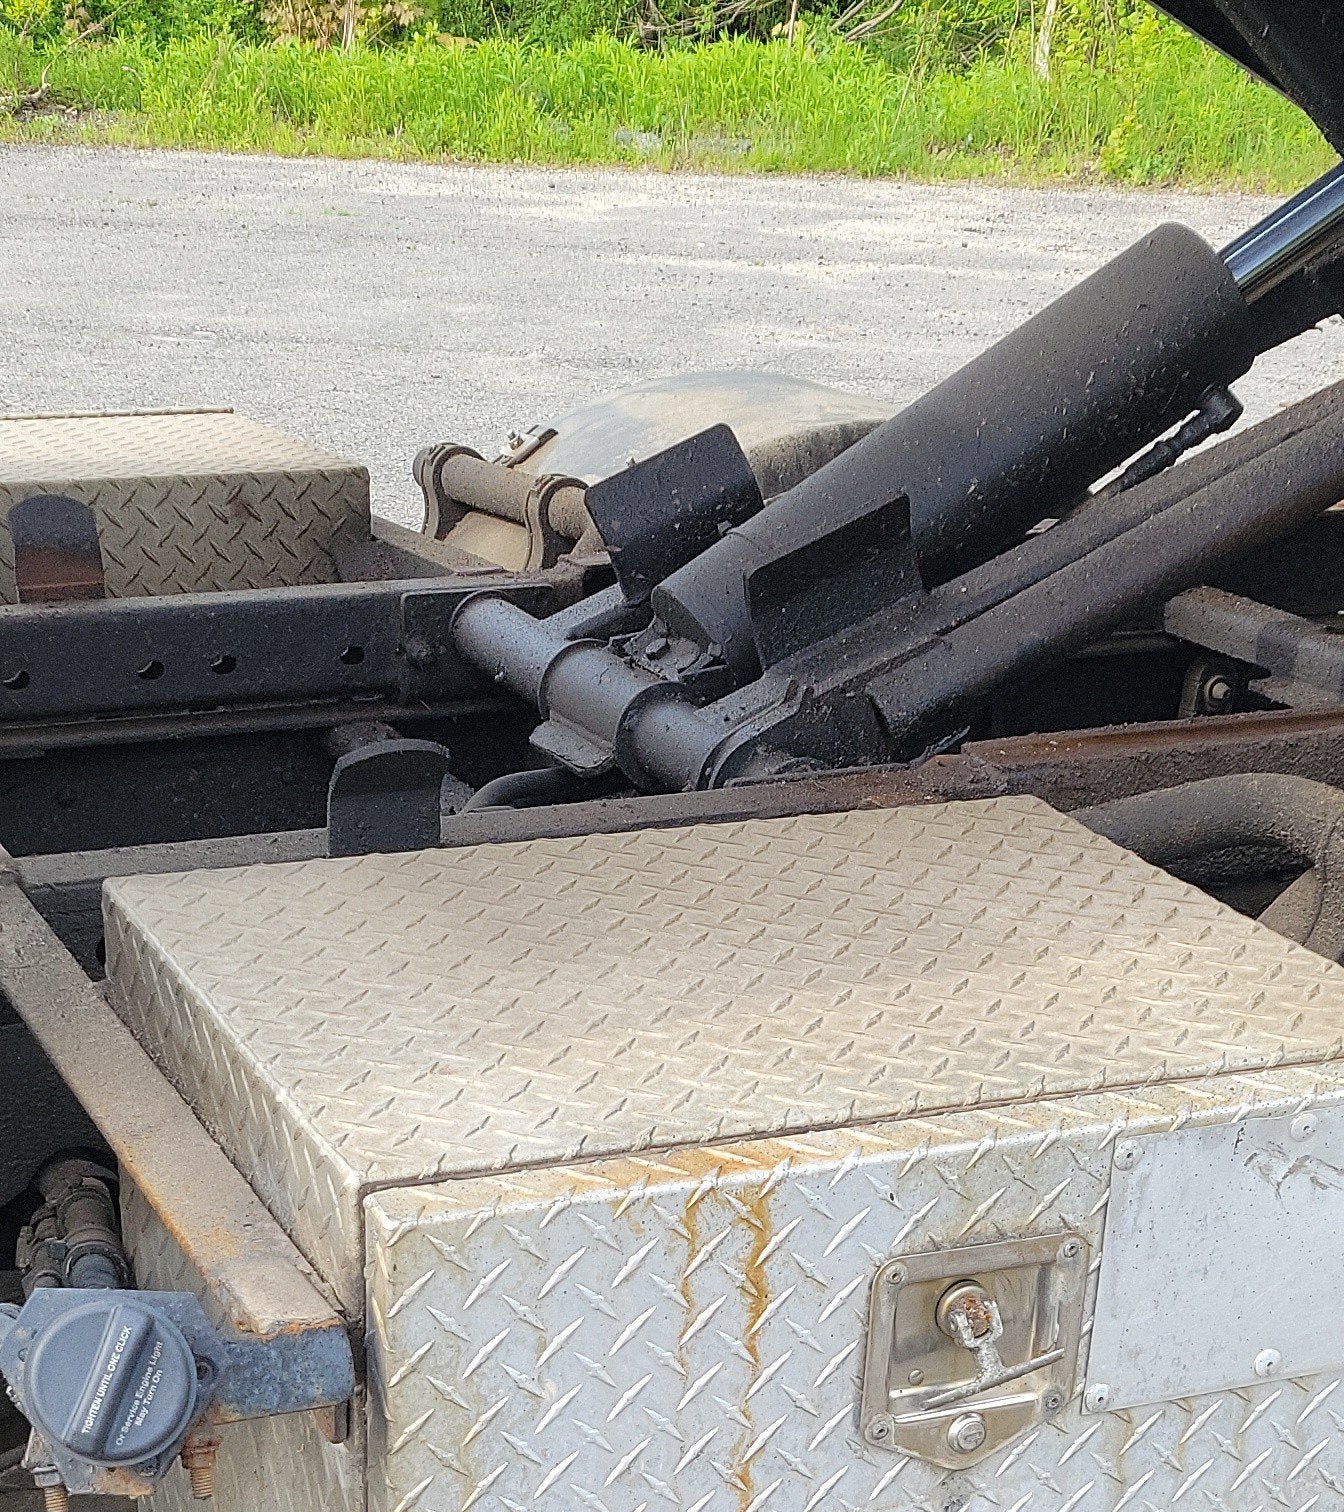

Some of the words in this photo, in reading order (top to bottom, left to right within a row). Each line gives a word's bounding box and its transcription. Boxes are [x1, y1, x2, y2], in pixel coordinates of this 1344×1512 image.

[81, 1398, 103, 1434] TIGHTEN
[97, 1372, 113, 1397] UNTIL
[107, 1353, 121, 1371] ONE
[115, 1325, 132, 1352] CLICK
[121, 1399, 141, 1433] Service
[135, 1366, 154, 1399] Engine
[149, 1341, 164, 1365] Light
[134, 1407, 149, 1427] May
[142, 1384, 157, 1405] Turn
[152, 1369, 164, 1383] On
